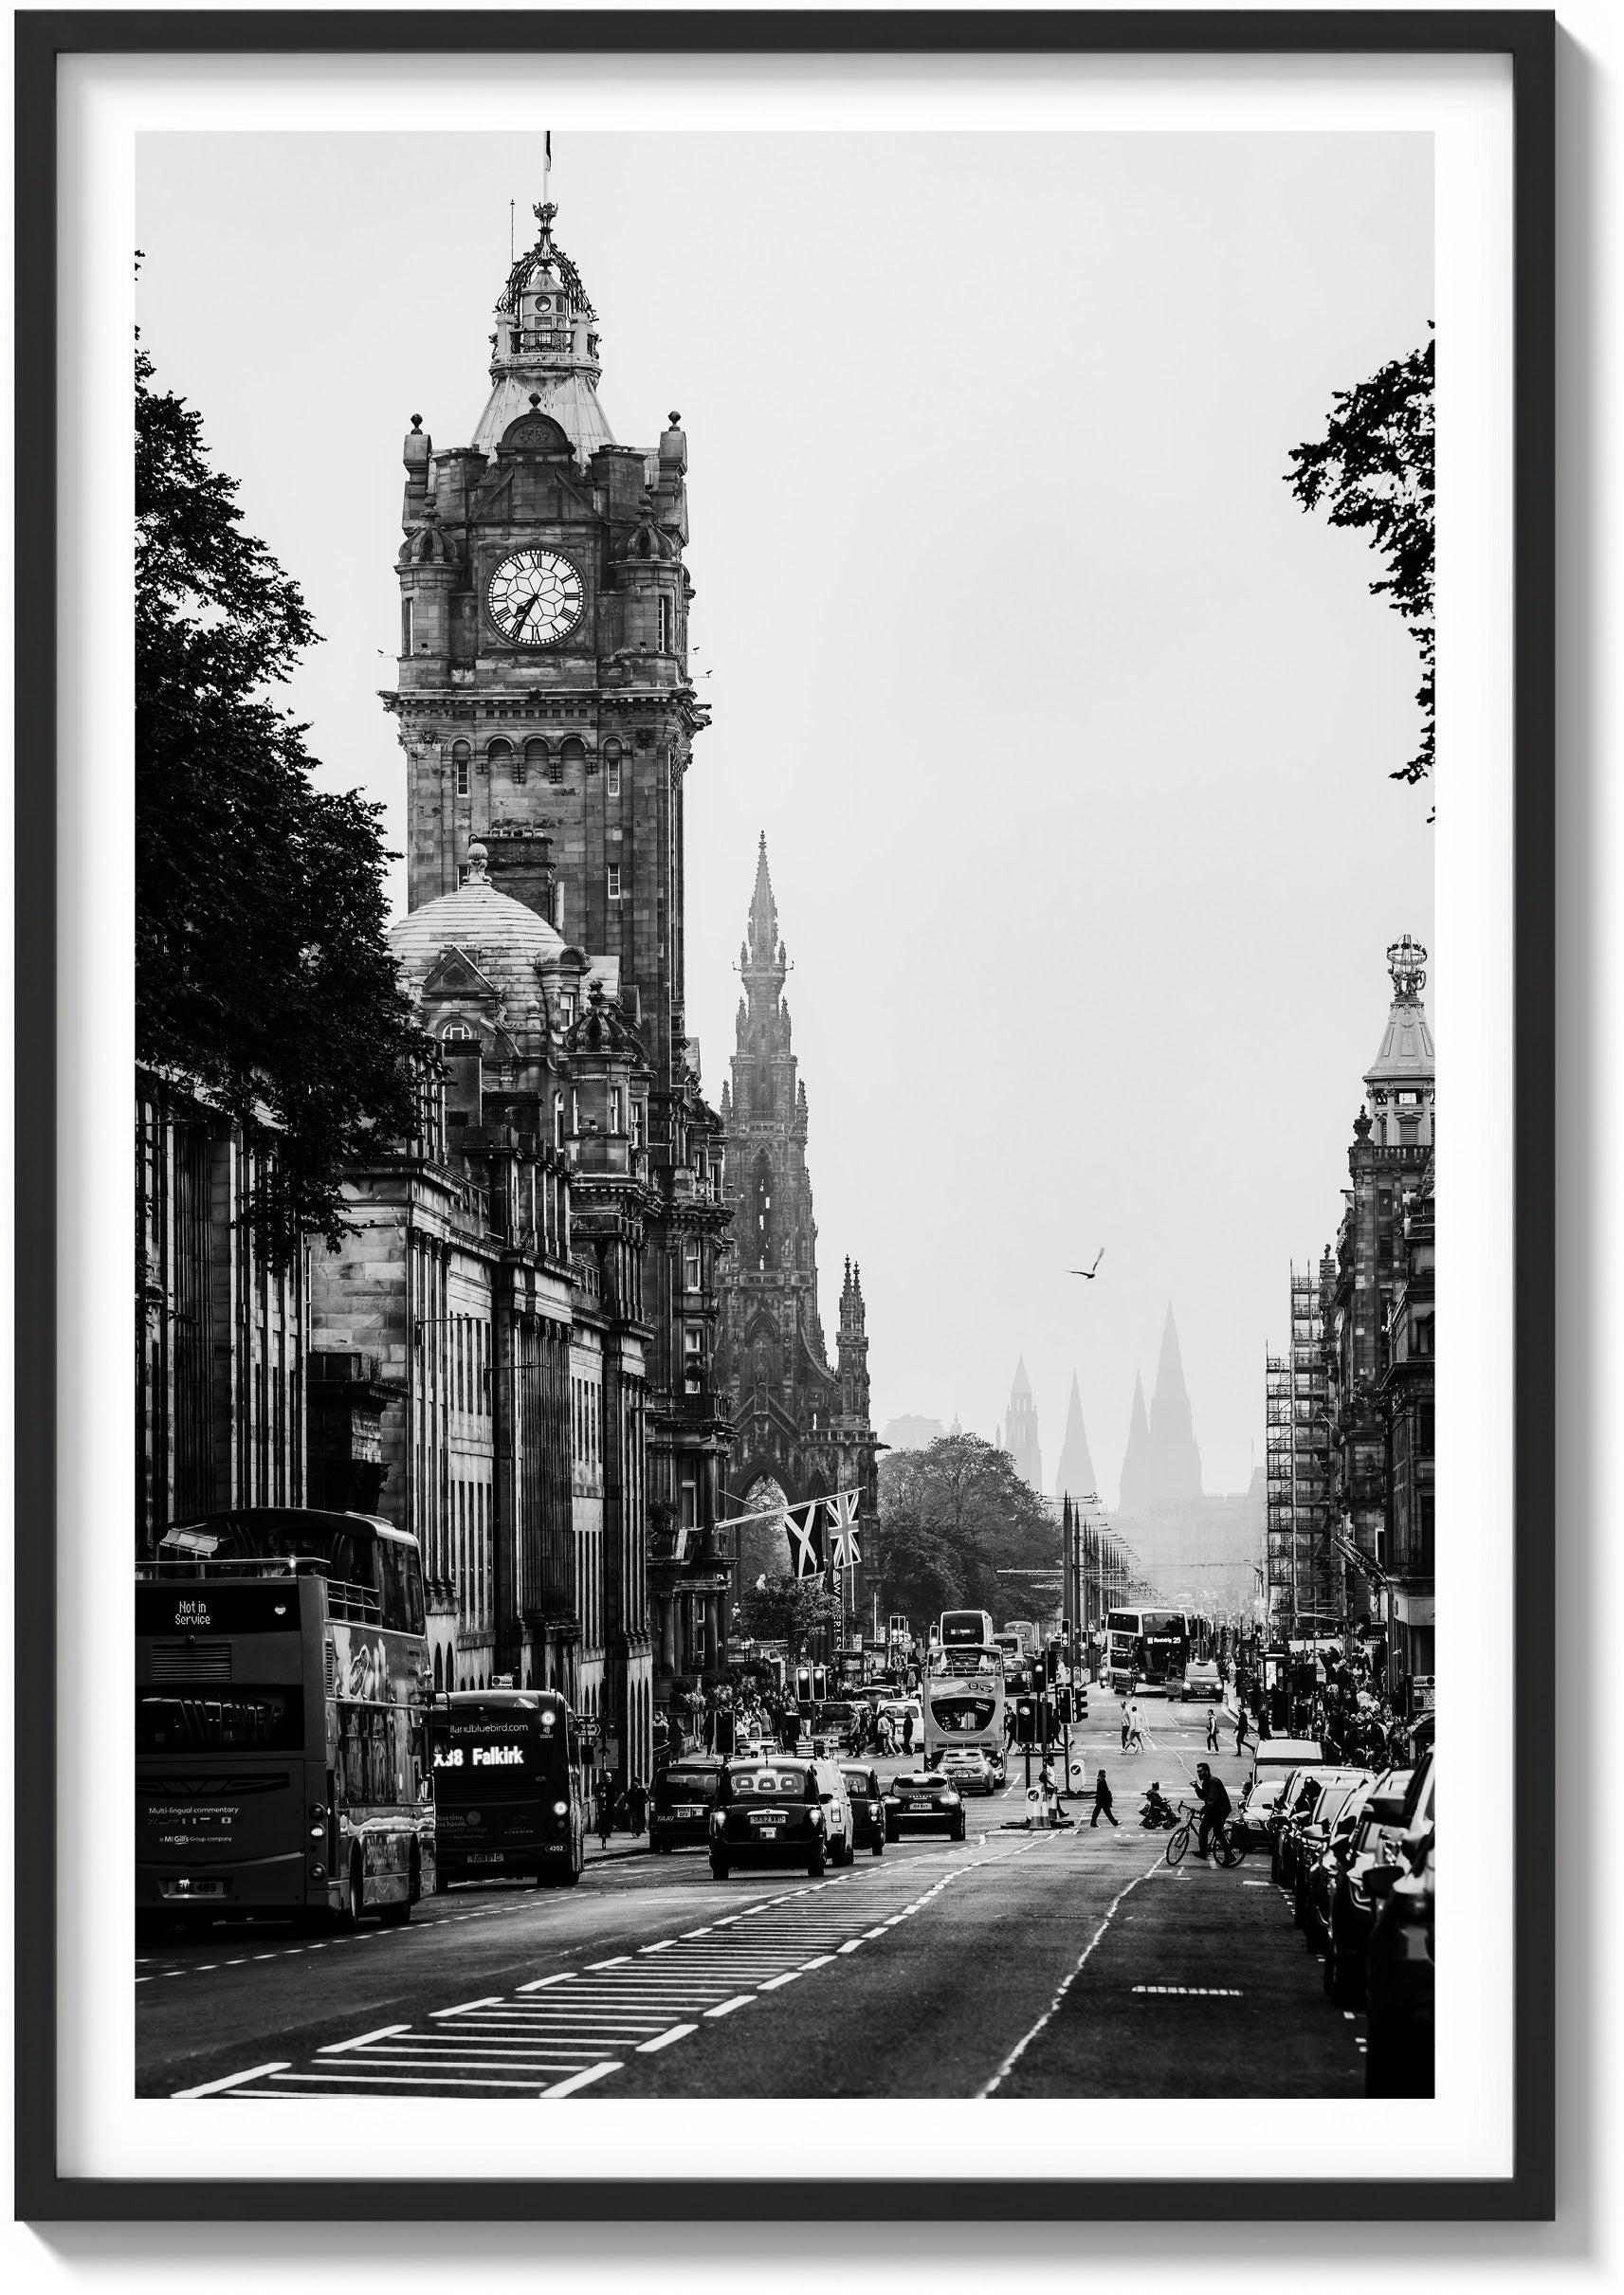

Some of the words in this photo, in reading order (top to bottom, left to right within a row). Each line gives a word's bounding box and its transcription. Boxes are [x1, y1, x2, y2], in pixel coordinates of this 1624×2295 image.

[179, 1600, 195, 1613] Not
[198, 1600, 207, 1613] in
[175, 1613, 210, 1625] Service
[472, 1745, 524, 1766] Falkirk
[149, 1807, 192, 1815] Multi-lingual
